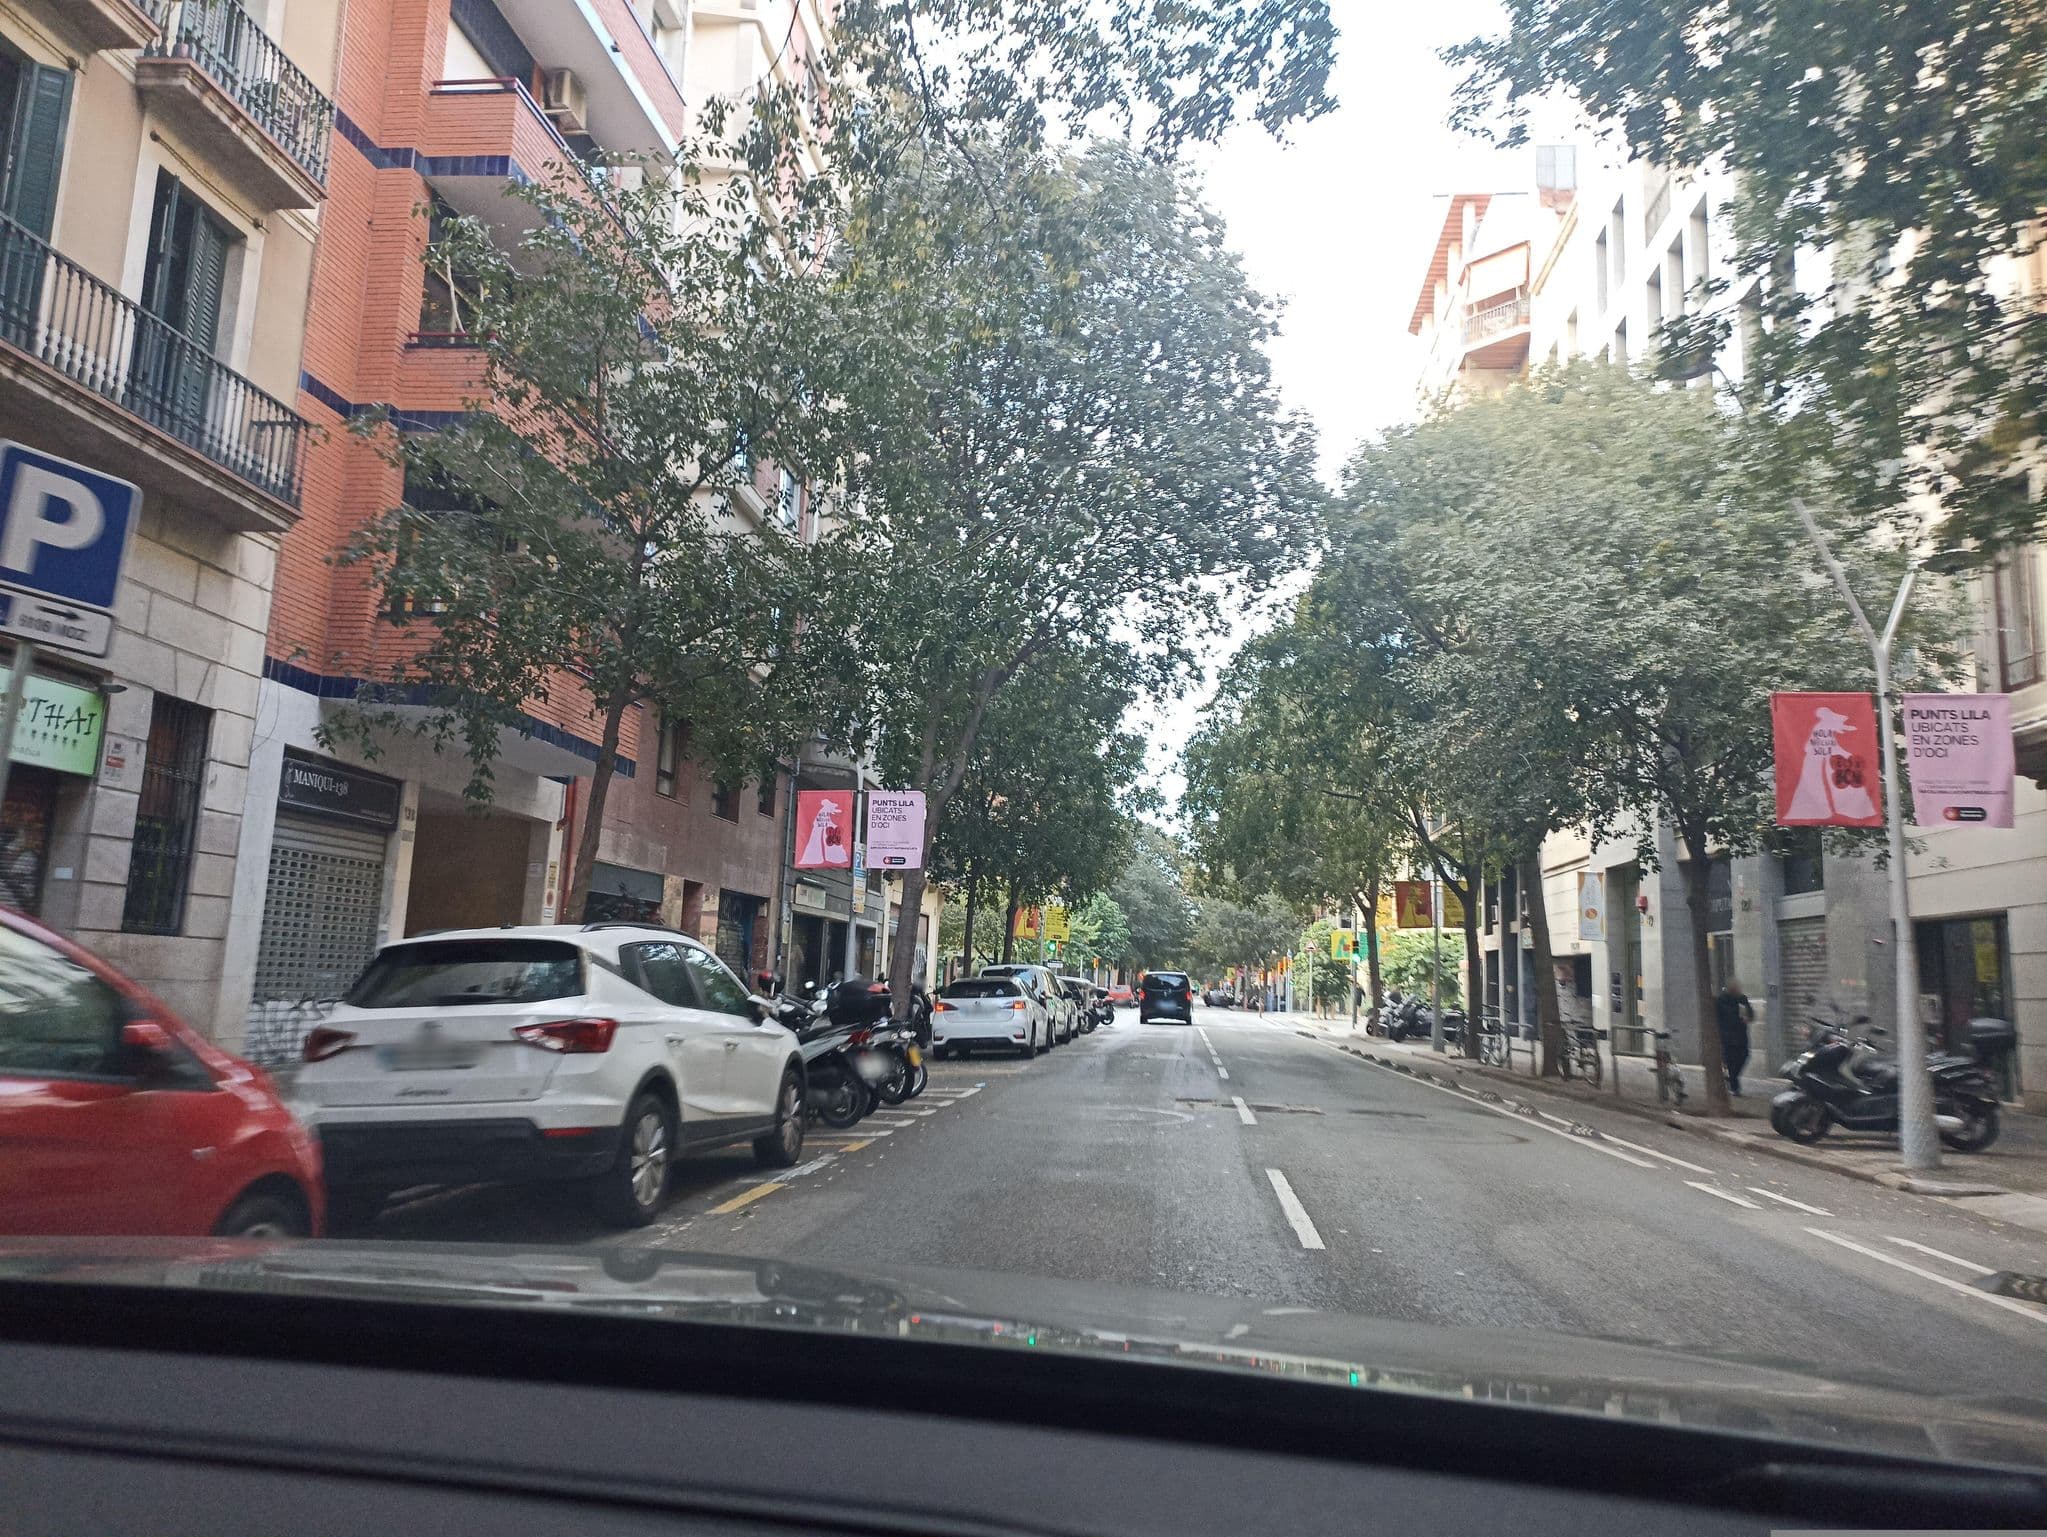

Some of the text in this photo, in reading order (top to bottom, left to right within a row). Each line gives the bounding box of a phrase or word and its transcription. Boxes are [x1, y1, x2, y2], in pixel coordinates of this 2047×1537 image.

[0, 461, 106, 575] P
[29, 696, 97, 735] THAI
[1910, 709, 1991, 720] PUNTS LILA
[1911, 722, 1969, 733] UBICATS
[1912, 734, 1979, 746] EN ZONES
[1914, 747, 1949, 758] D'OCI
[293, 768, 349, 797] MANIQUI-138
[872, 799, 898, 807] PUNTS
